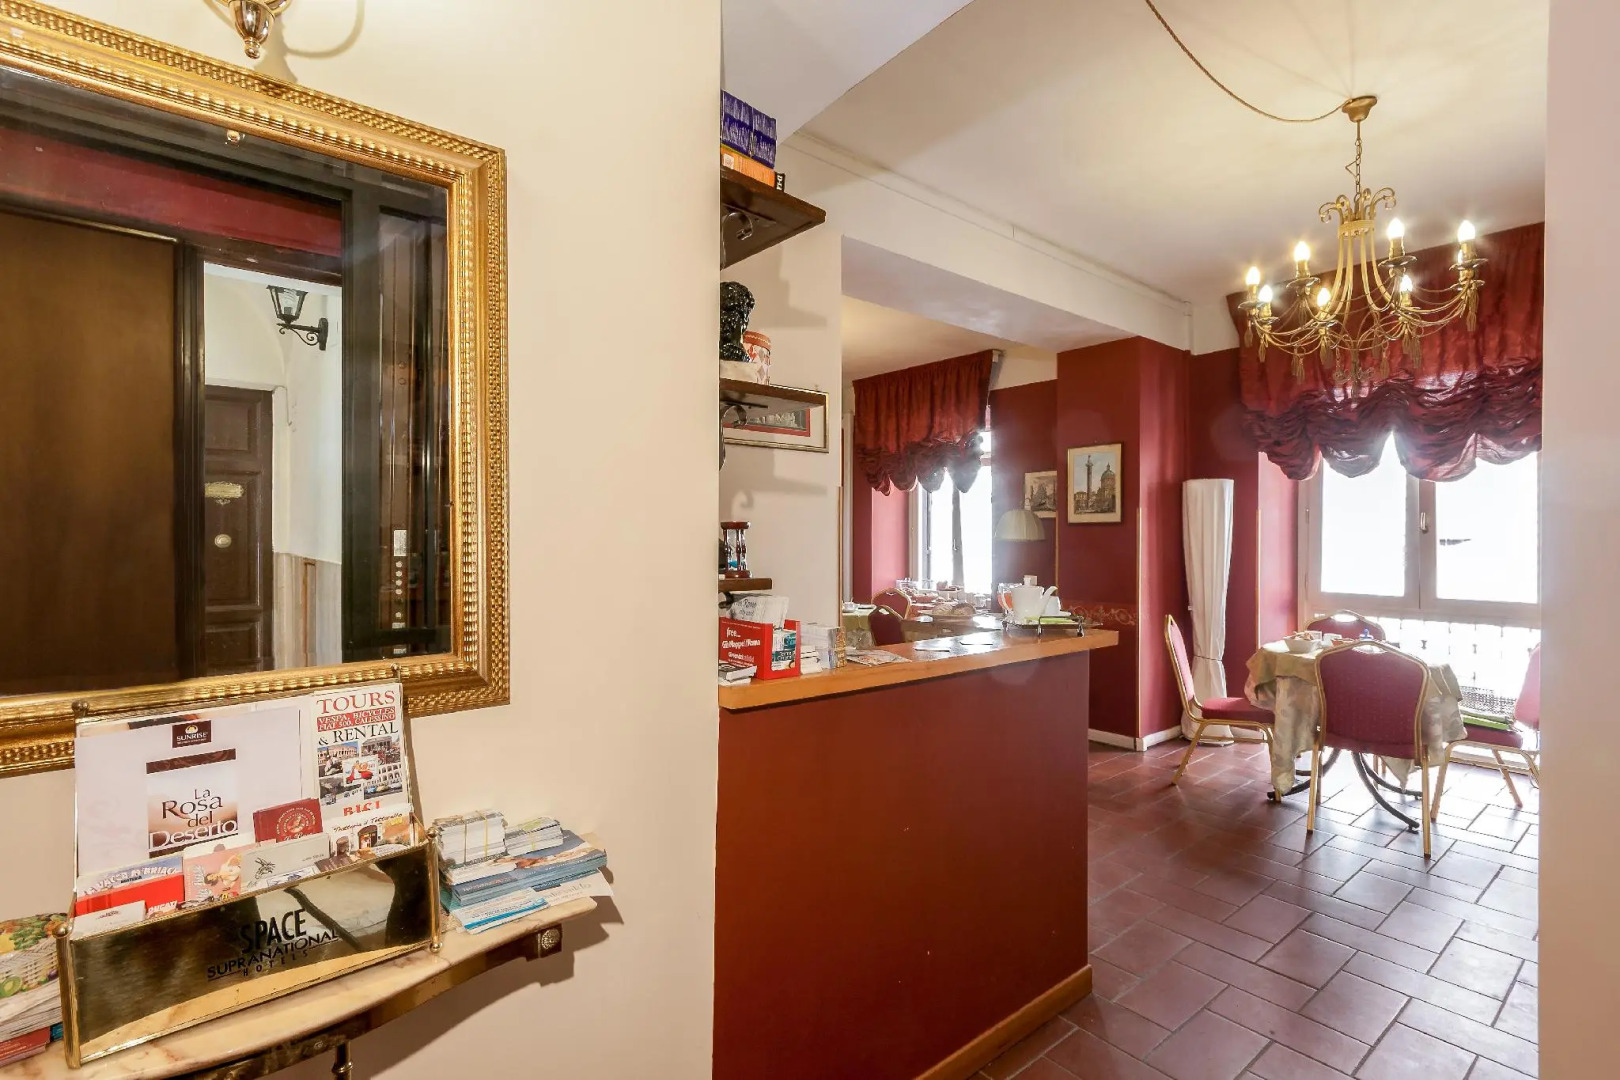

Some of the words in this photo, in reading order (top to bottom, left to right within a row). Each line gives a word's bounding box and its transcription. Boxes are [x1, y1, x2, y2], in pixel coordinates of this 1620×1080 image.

[316, 690, 395, 714] TOURS
[318, 714, 351, 724] VESPA,
[352, 707, 395, 718] BICYCLES
[318, 721, 337, 731] FIAT
[355, 713, 396, 725] CALESSINO
[176, 732, 207, 742] SUNRISE
[318, 737, 329, 746] &
[333, 722, 399, 744] RENTAL
[194, 788, 211, 800] La
[161, 796, 223, 819] Rosa
[187, 811, 213, 828] del
[149, 820, 238, 850] Deserto
[239, 908, 307, 954] SPACE
[207, 929, 339, 978] SUPRANATIONAL
[243, 950, 308, 977] HOTELS
